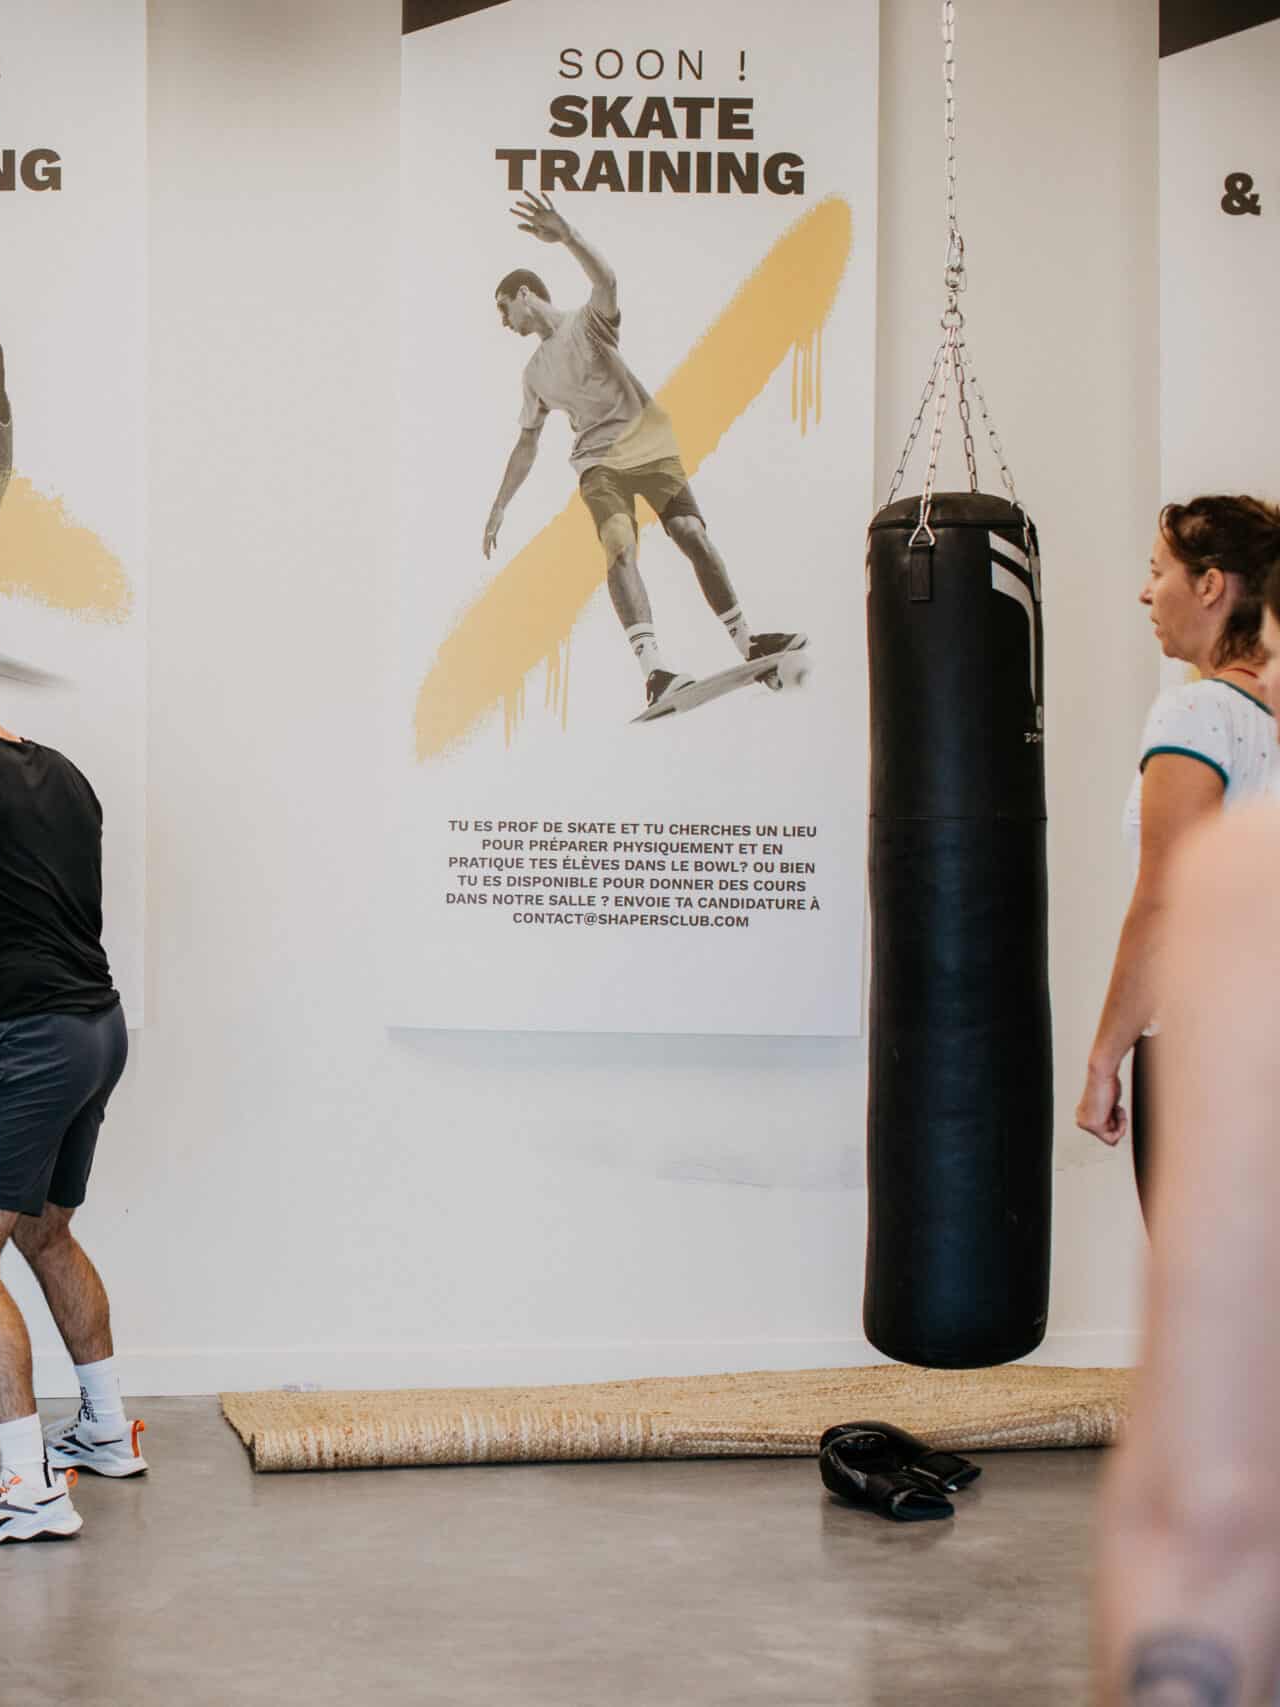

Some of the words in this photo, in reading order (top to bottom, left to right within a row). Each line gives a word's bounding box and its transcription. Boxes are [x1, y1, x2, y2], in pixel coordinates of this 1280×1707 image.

[558, 47, 703, 81] SOON
[738, 50, 746, 81] !
[548, 94, 755, 141] SKATE
[495, 148, 805, 197] TRAINING
[1220, 171, 1261, 217] &
[447, 820, 469, 832] TU
[473, 820, 493, 832] ES
[497, 820, 539, 833] PROF
[543, 821, 563, 833] DE
[567, 822, 617, 835] SKATE
[620, 823, 641, 835] ET
[643, 823, 664, 835] TU
[668, 823, 752, 837] CHERCHES
[755, 824, 778, 837] UN
[782, 825, 817, 838] LIEU
[482, 839, 524, 851] POUR
[528, 836, 609, 853] PRÉPARER
[613, 840, 735, 857] PHYSIQUEMENT
[738, 842, 759, 855] ET
[762, 843, 783, 856] EN
[448, 856, 525, 872] PRATIQUE
[528, 857, 558, 870] TES
[562, 856, 620, 871] ÉLÈVES
[624, 859, 667, 872] DANS
[670, 860, 689, 872] LE
[693, 860, 749, 873] BOWL?
[752, 861, 775, 874] OU
[779, 861, 816, 875] BIEN
[457, 874, 478, 887] TU
[482, 875, 502, 887] ES
[506, 875, 598, 889] DISPONIBLE
[602, 877, 645, 889] POUR
[649, 878, 714, 891] DONNER
[718, 879, 749, 892] DES
[753, 879, 807, 893] COURS
[445, 892, 488, 905] DANS
[492, 893, 545, 906] NOTRE
[548, 894, 597, 907] SALLE
[600, 895, 610, 907] ?
[614, 895, 671, 908] ENVOIE
[674, 896, 694, 909] TA
[697, 896, 807, 911] CANDIDATURE
[809, 895, 821, 911] À
[512, 912, 750, 928] CONTACT@SHAPERSCLUB.COM
